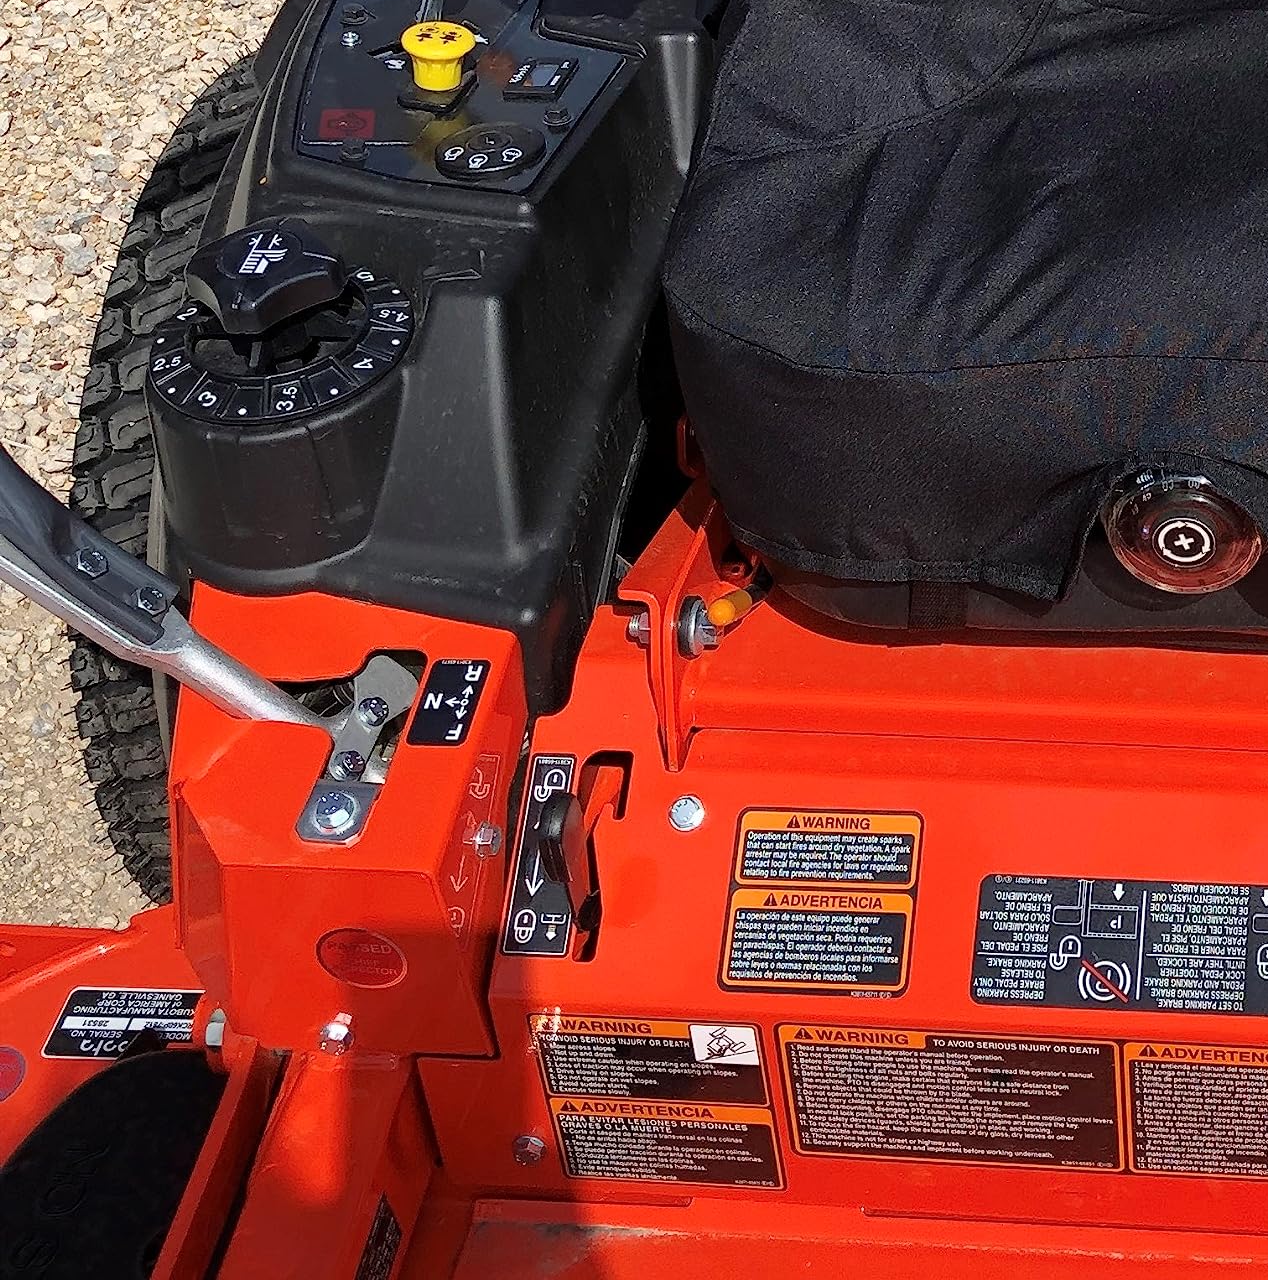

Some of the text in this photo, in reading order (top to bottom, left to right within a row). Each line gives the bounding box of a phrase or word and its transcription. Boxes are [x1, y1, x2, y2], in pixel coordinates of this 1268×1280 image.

[177, 307, 197, 320] 2
[378, 308, 409, 323] 4.5
[152, 355, 181, 371] 2.5
[353, 357, 374, 370] 4
[197, 390, 217, 407] 3
[275, 385, 298, 411] 3.5
[464, 664, 483, 682] R
[424, 692, 443, 709] N
[445, 724, 463, 741] F
[802, 816, 870, 830] WARNING
[748, 832, 902, 845] Operation of this equipment may create sparks
[780, 894, 882, 909] ADVERTENCIA
[986, 958, 1047, 968] PARKING BRAKE.
[1155, 958, 1246, 969] UNTIL THEY ARE LOCKED.
[1001, 968, 1046, 979] TO RELEASE
[1160, 968, 1246, 979] LOCK PEDAL TOGETHER
[973, 977, 1044, 988] BRAKE PEDAL ONLY
[1144, 977, 1245, 990] PEDAL AND PARKING BRAKE
[977, 988, 1044, 999] DEPRESS PARKING
[1150, 988, 1244, 1000] DEPRESS PARKING BRAKE
[73, 1006, 156, 1015] MANUFACTURING
[1156, 998, 1243, 1011] TO SET PARKING BRAKE,
[560, 1020, 652, 1034] WARNING
[580, 1037, 616, 1045] SERIOUS
[618, 1038, 646, 1046] INJURY
[663, 1040, 690, 1048] DEATH
[814, 1029, 909, 1045] WARNING
[933, 1038, 1100, 1055] TO AVOID SERIOUS INJURY OR DEATH
[580, 1103, 714, 1118] ADVERTENCIA
